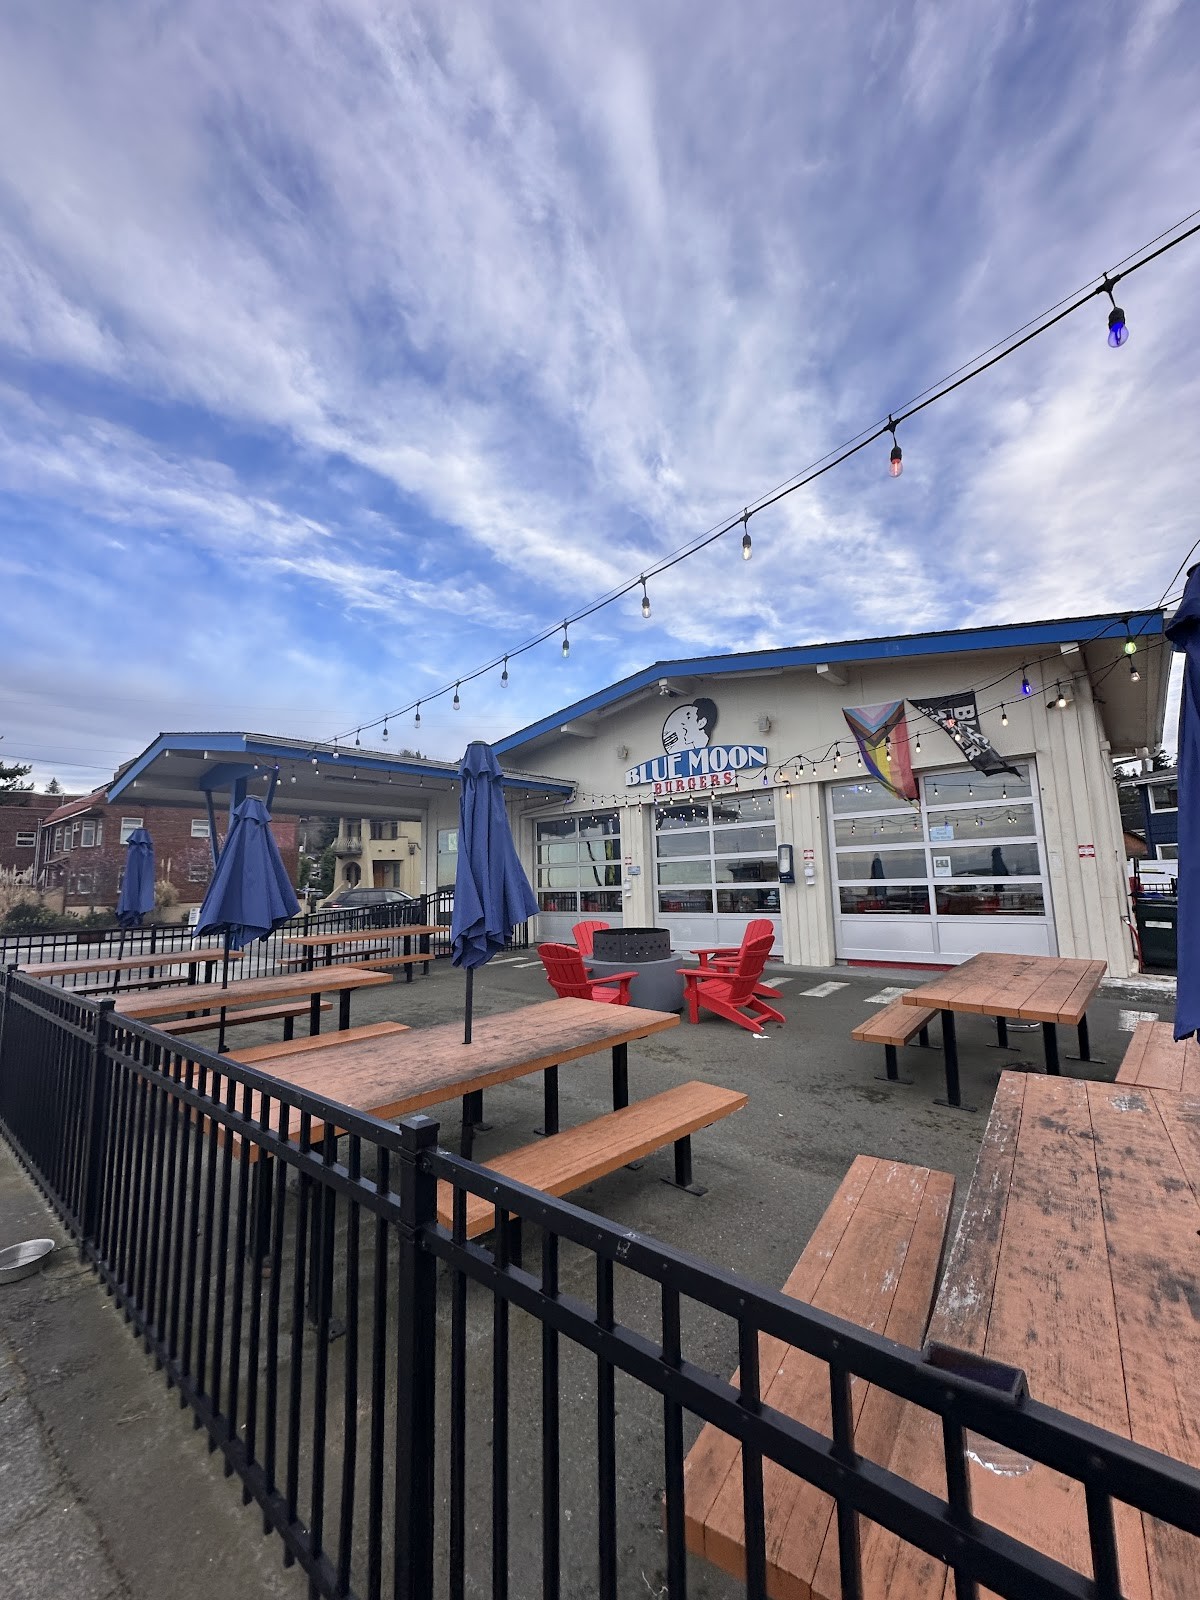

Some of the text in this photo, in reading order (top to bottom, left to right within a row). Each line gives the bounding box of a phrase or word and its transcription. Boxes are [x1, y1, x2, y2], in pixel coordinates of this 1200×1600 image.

[625, 745, 768, 786] BLUE MOON
[653, 771, 733, 795] BURGERS
